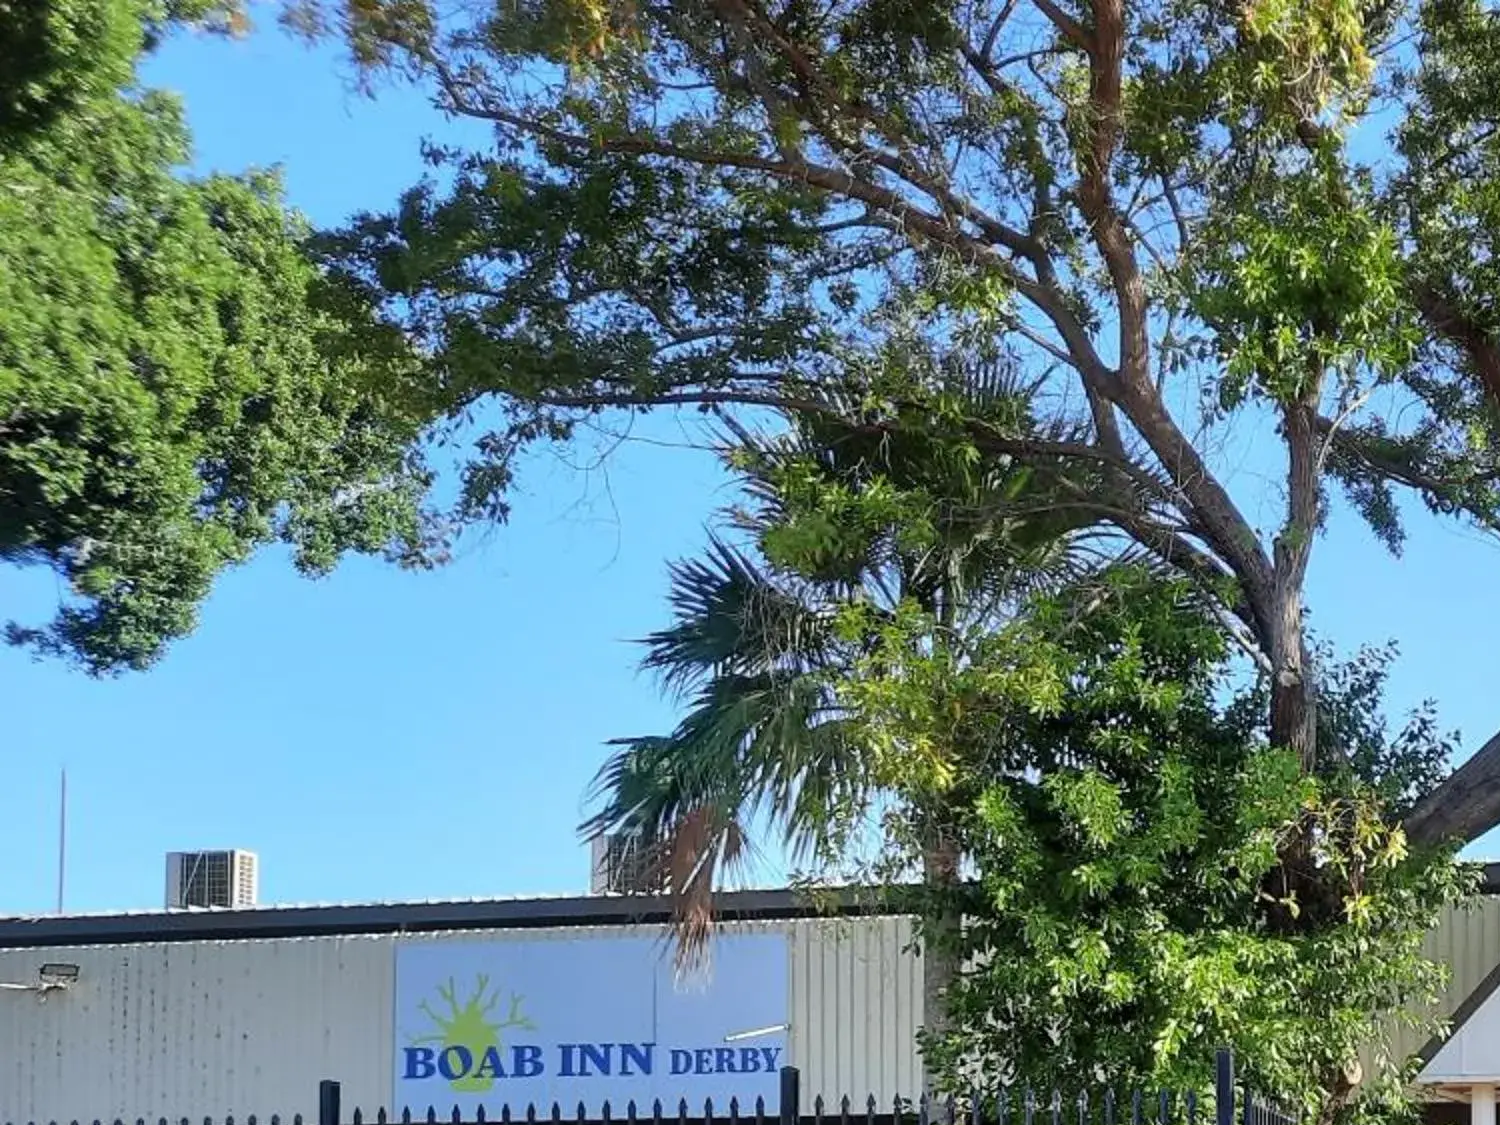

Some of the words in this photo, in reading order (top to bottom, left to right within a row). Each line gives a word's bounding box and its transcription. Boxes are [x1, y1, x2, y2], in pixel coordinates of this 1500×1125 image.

[403, 1044, 544, 1081] BOAB
[557, 1042, 657, 1077] INN
[669, 1046, 783, 1074] DERBY
